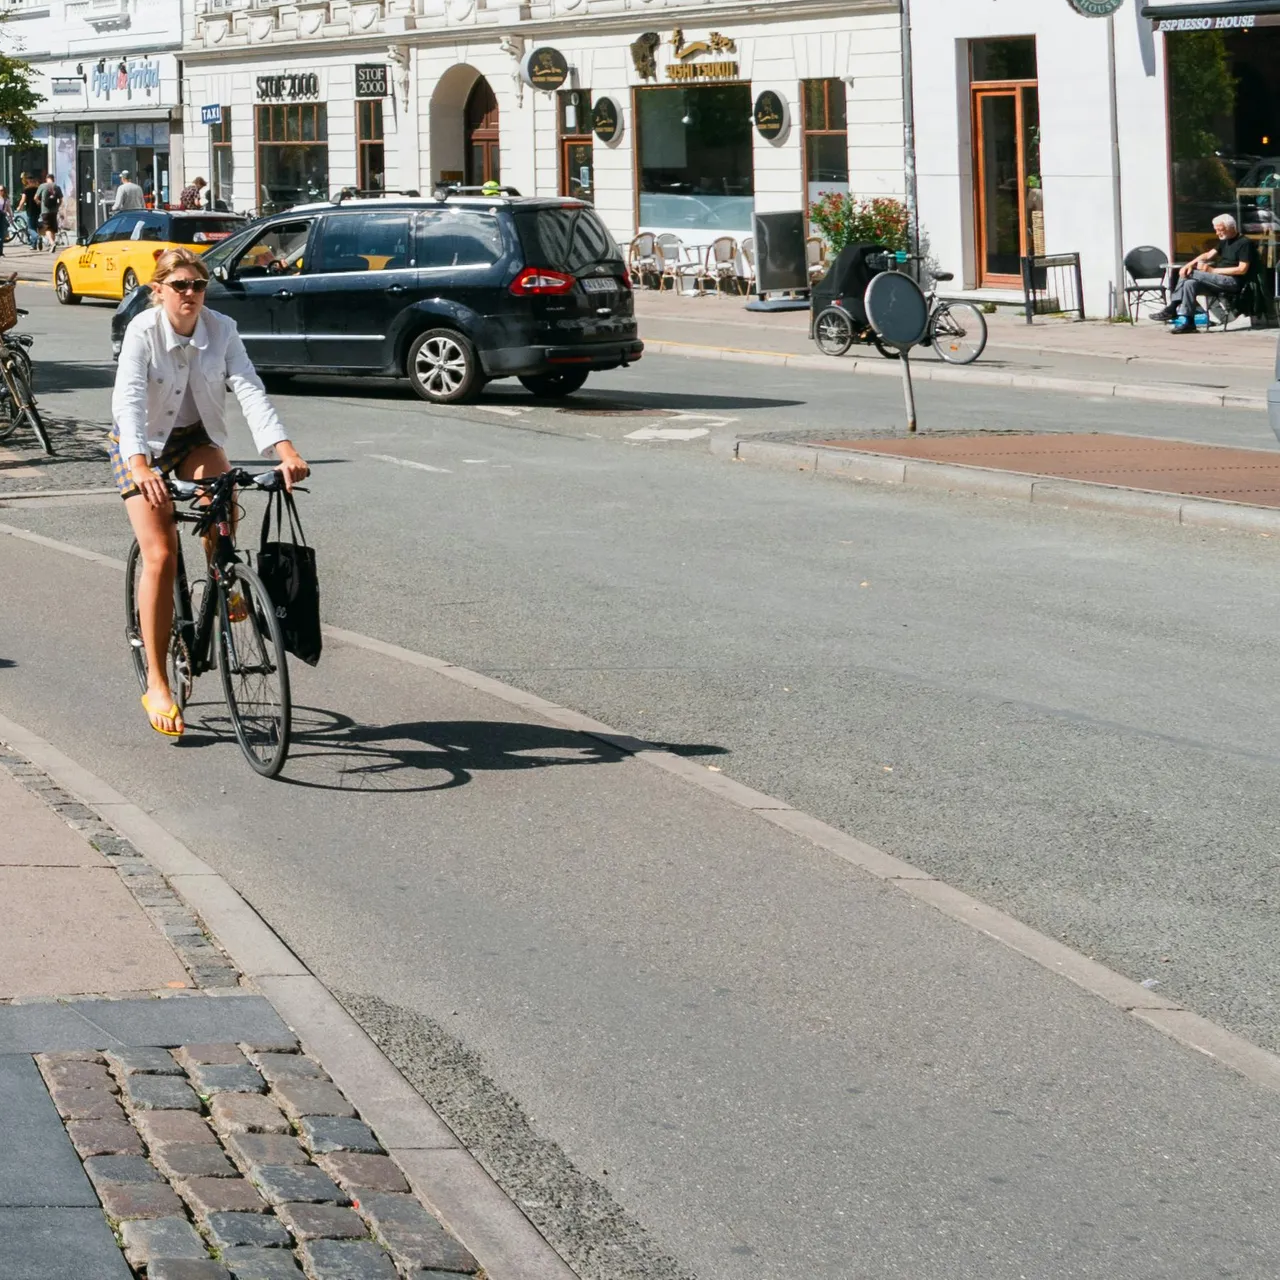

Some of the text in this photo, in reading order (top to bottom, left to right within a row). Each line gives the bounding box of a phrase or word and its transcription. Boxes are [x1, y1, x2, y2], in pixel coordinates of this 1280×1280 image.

[1158, 15, 1255, 31] ESPRESSO HOUSE
[358, 68, 385, 81] STOF
[665, 64, 694, 79] SUSHI
[256, 73, 318, 99] STOF 2000
[359, 80, 386, 93] 2000
[202, 107, 220, 120] TAXI
